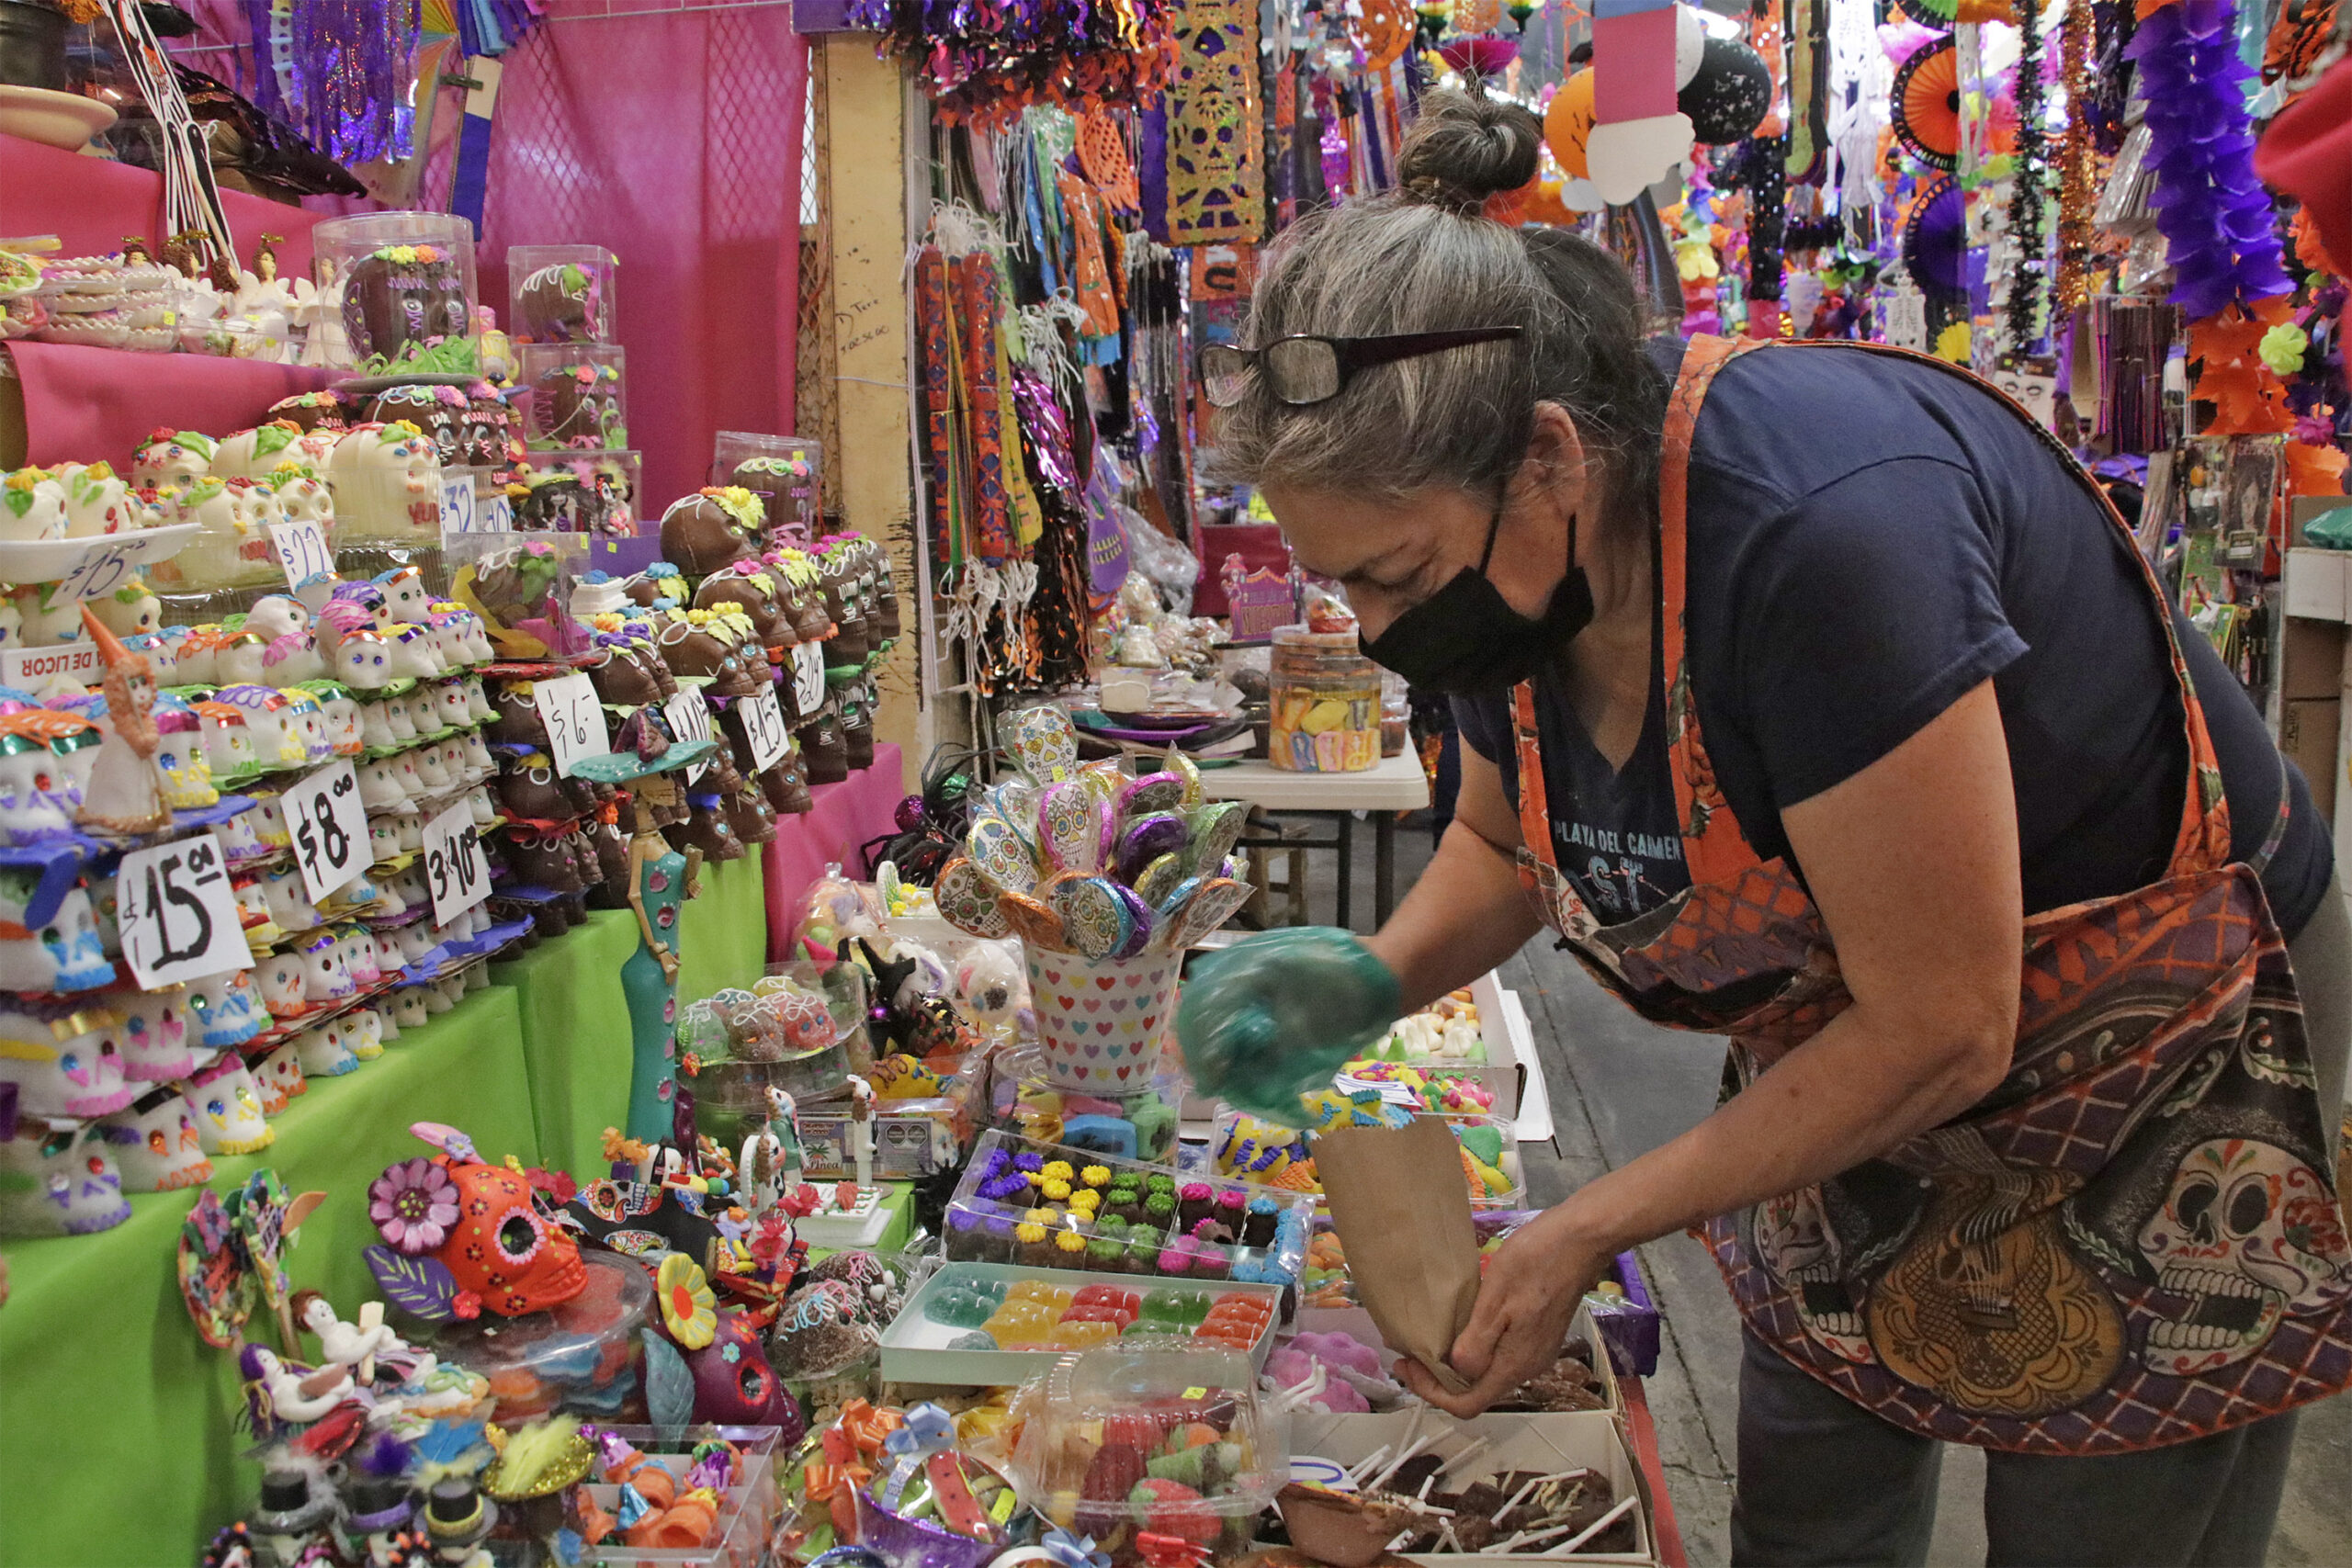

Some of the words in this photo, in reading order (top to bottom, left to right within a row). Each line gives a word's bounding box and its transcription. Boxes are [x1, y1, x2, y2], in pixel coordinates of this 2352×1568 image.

[22, 654, 70, 678] LICOR
[73, 651, 92, 671] DE
[1598, 829, 1624, 854] DEL
